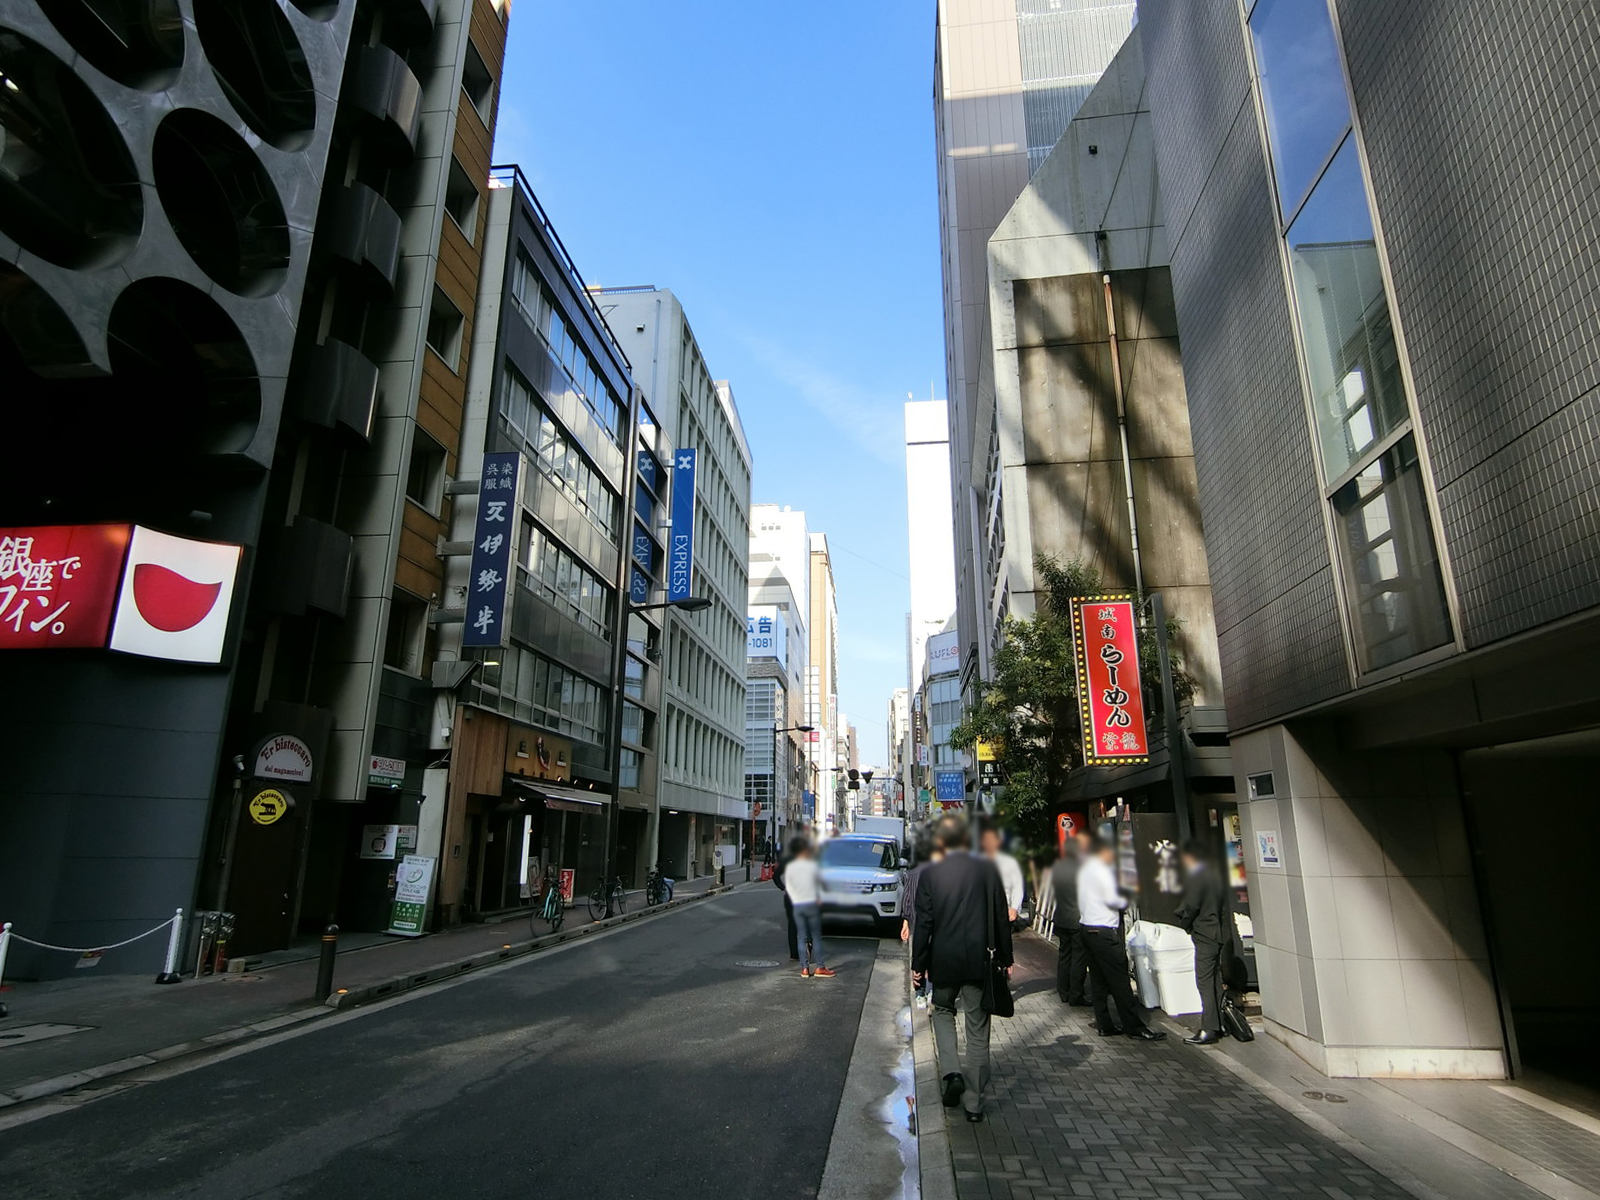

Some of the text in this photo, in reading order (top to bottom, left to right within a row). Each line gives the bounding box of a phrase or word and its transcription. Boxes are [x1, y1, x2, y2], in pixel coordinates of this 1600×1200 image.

[484, 463, 499, 490] 呉服
[0, 536, 81, 591] 銀座で
[672, 535, 688, 594] EXPRESS
[1100, 643, 1132, 728] らーめん
